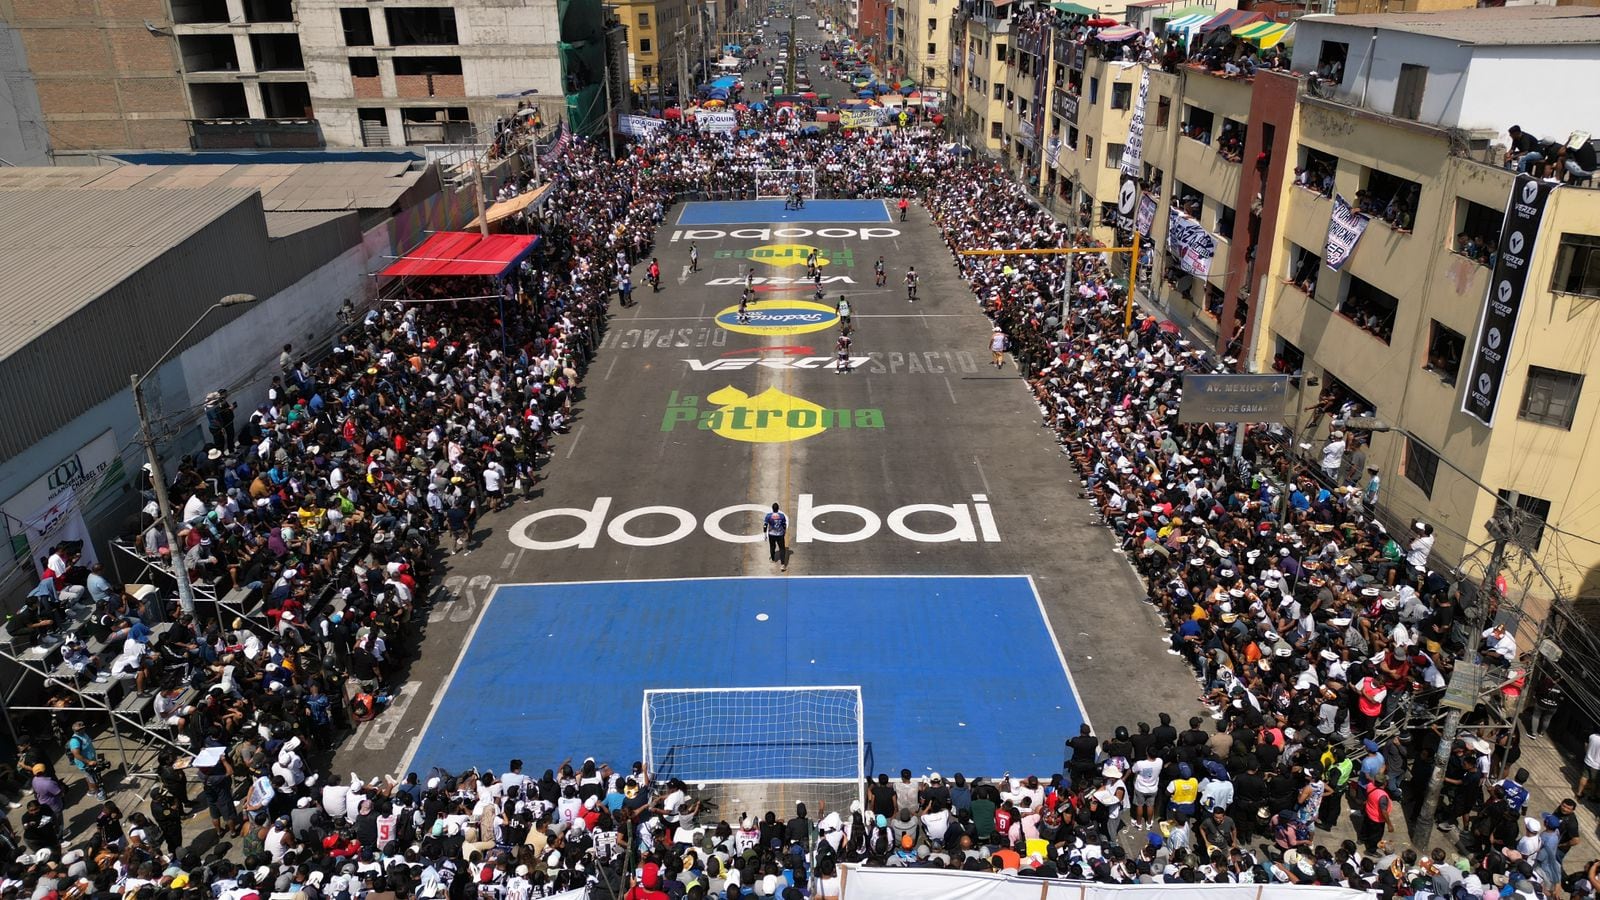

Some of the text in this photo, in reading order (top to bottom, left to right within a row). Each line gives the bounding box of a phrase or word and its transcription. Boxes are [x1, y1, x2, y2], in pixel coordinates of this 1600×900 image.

[631, 119, 663, 127] JOAQUI
[1515, 203, 1537, 216] VERZA
[1503, 252, 1524, 266] VERZA
[1491, 300, 1512, 314] VERZA
[1481, 346, 1501, 361] VERZA
[856, 351, 979, 374] SPACIO
[1206, 384, 1221, 392] AV.
[667, 390, 698, 407] La
[1472, 391, 1491, 406] VERZA
[1229, 404, 1239, 412] DE
[660, 406, 885, 432] Patrona
[96, 462, 109, 473] TEX
